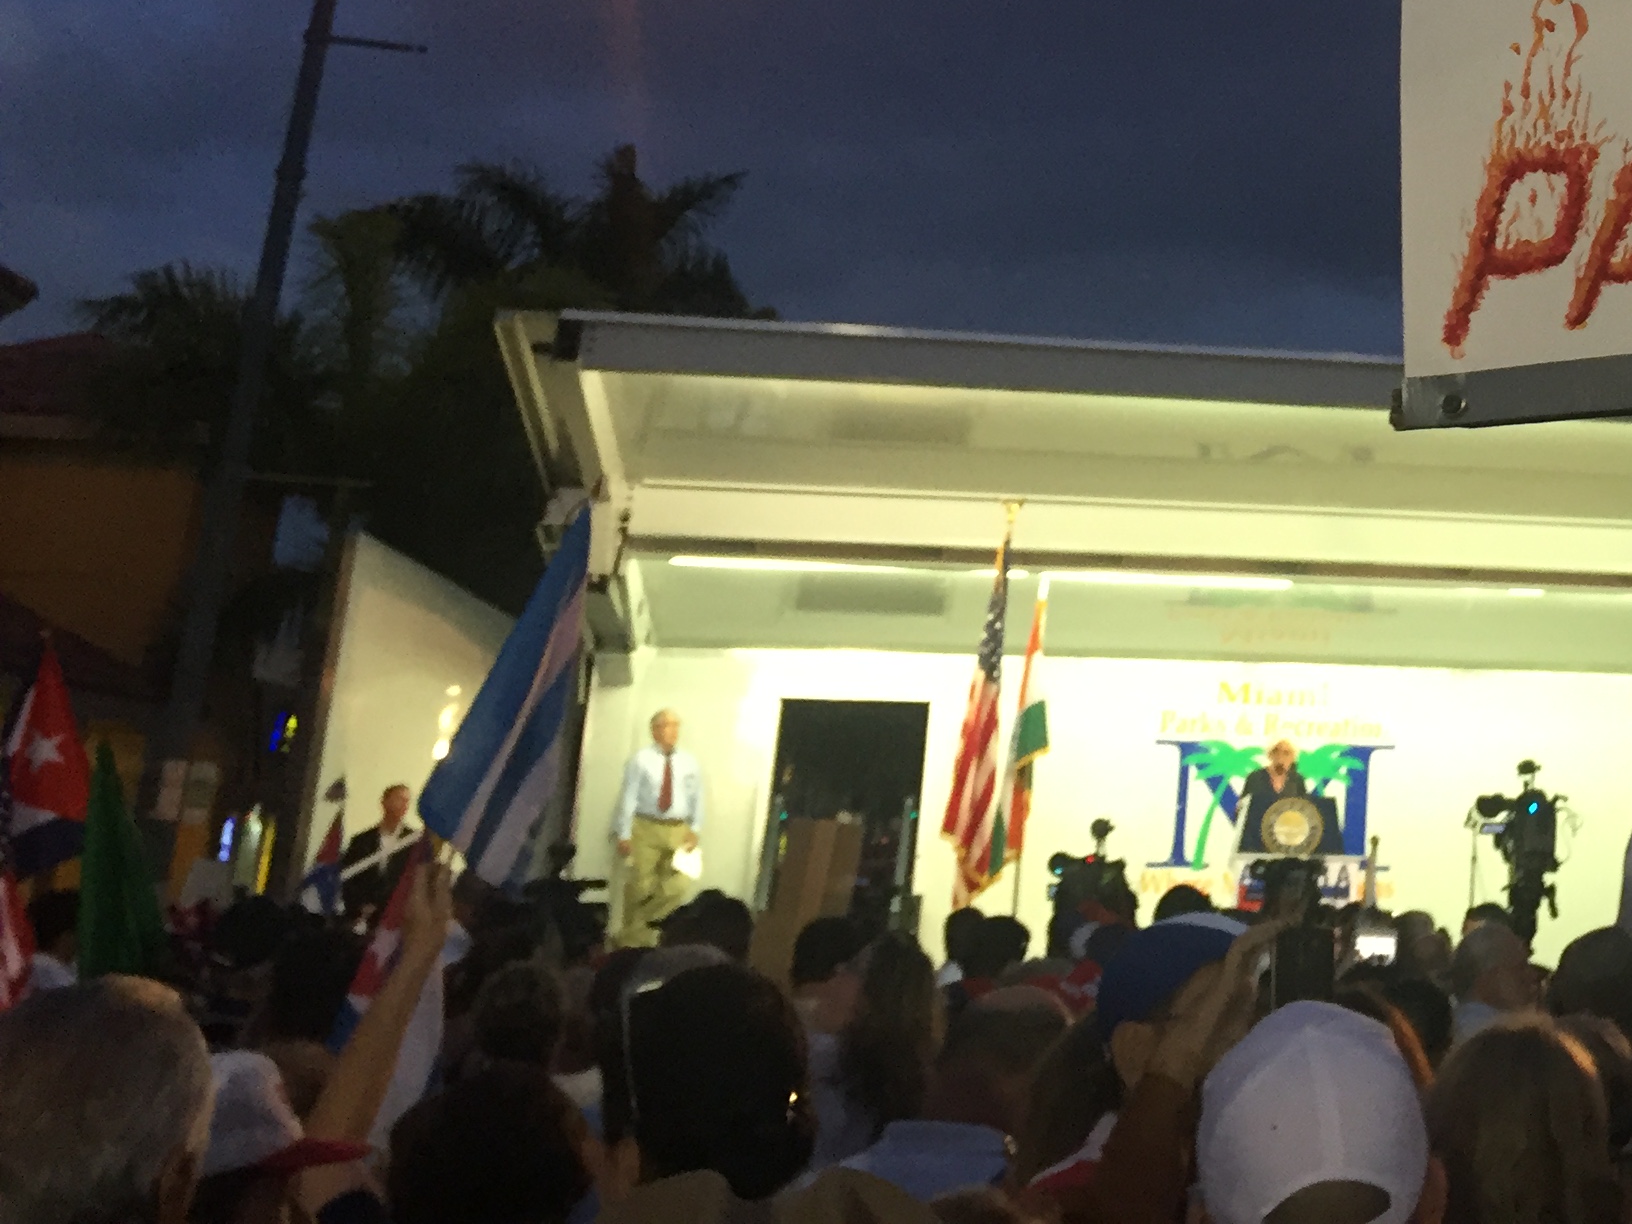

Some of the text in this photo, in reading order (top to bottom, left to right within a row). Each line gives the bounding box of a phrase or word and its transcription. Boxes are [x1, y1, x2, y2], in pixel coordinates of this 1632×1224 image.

[1217, 680, 1329, 706] Miami
[1160, 709, 1226, 734] Parks
[1263, 713, 1383, 739] Recreation
